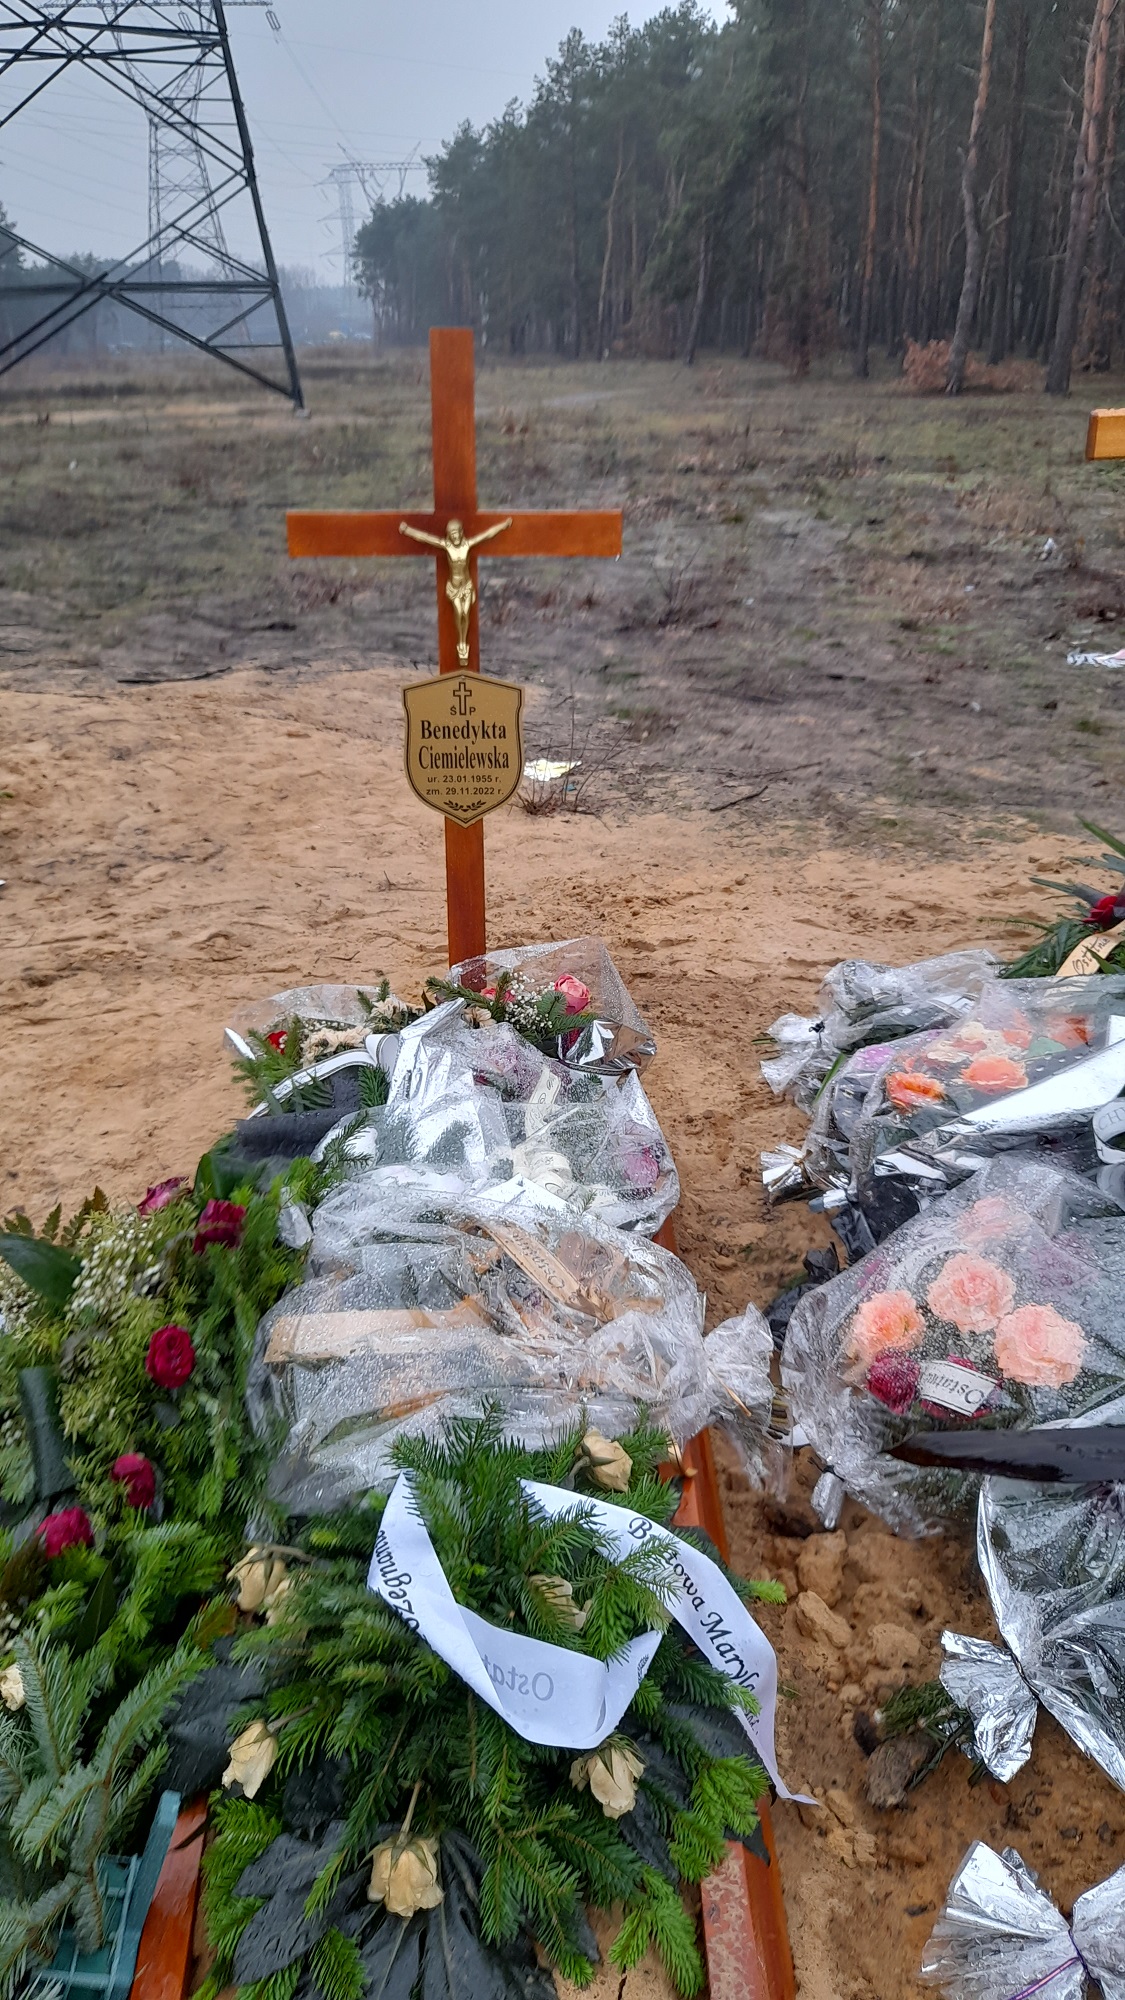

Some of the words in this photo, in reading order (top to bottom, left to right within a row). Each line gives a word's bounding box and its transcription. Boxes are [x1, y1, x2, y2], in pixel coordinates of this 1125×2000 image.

[450, 705, 457, 716] Ś
[469, 706, 477, 716] P
[420, 719, 507, 745] Benedykta
[418, 745, 510, 770] Ciemielewska
[427, 775, 440, 783] ur.
[442, 775, 493, 783] 23.01.1955
[495, 775, 502, 783] r.
[445, 787, 495, 795] 29.11.2022
[626, 1516, 706, 1613] Btowa
